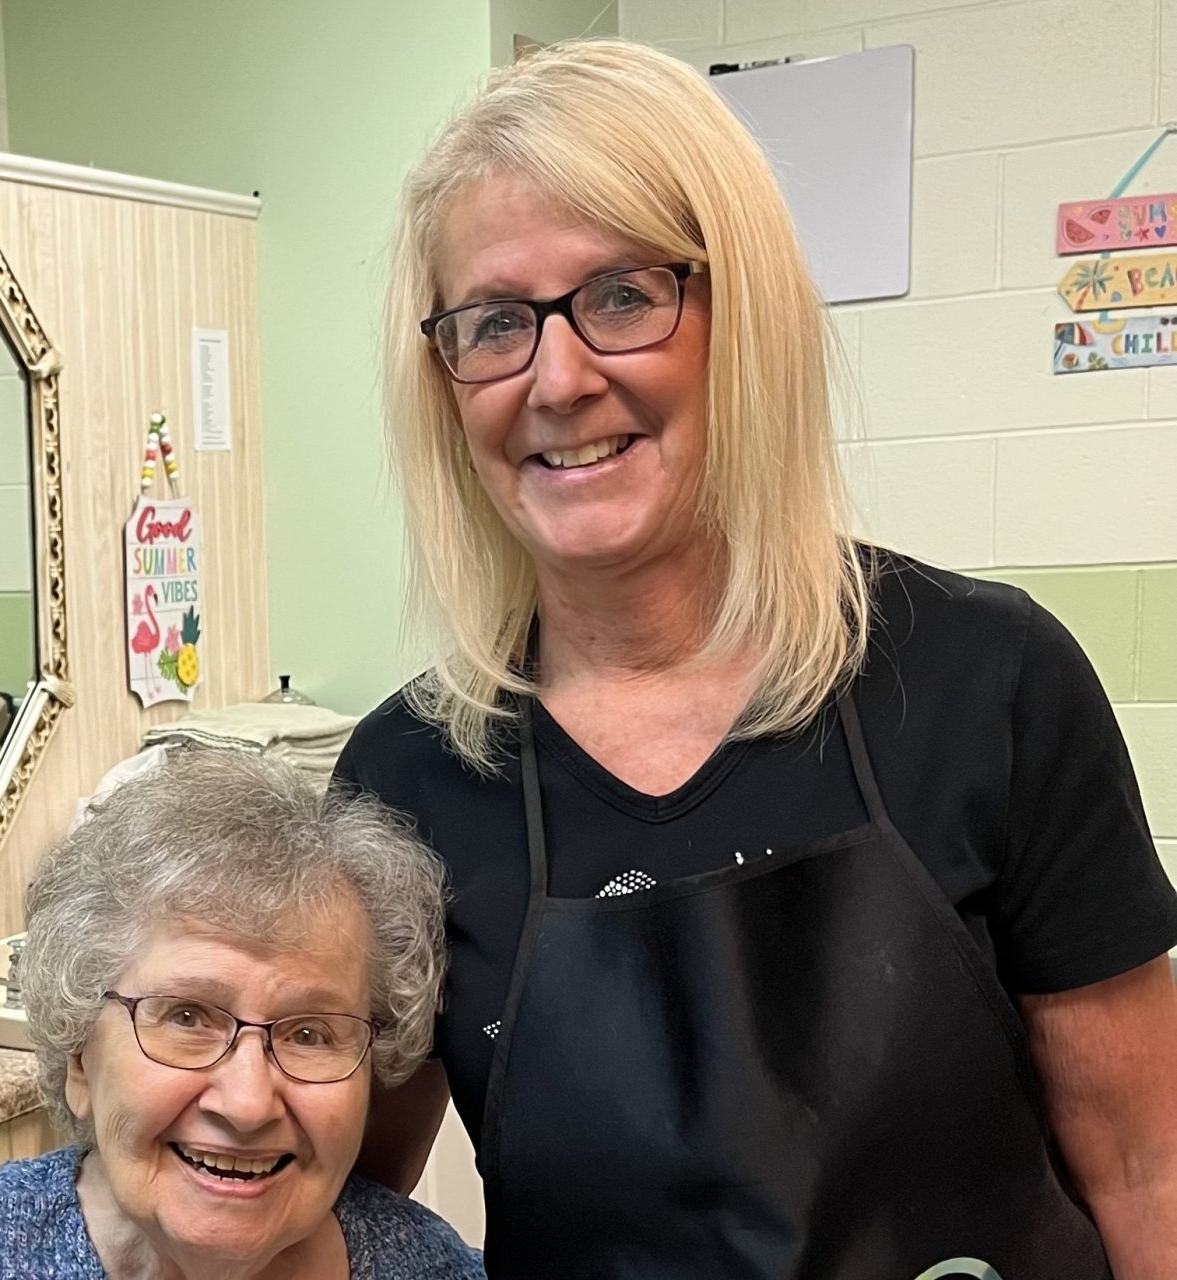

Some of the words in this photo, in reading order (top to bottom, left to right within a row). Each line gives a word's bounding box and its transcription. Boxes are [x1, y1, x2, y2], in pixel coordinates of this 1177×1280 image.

[1117, 200, 1177, 230] SUM
[1127, 263, 1177, 296] BEA
[136, 505, 192, 544] Good
[133, 547, 197, 575] SUMMER
[161, 580, 198, 603] VIBES
